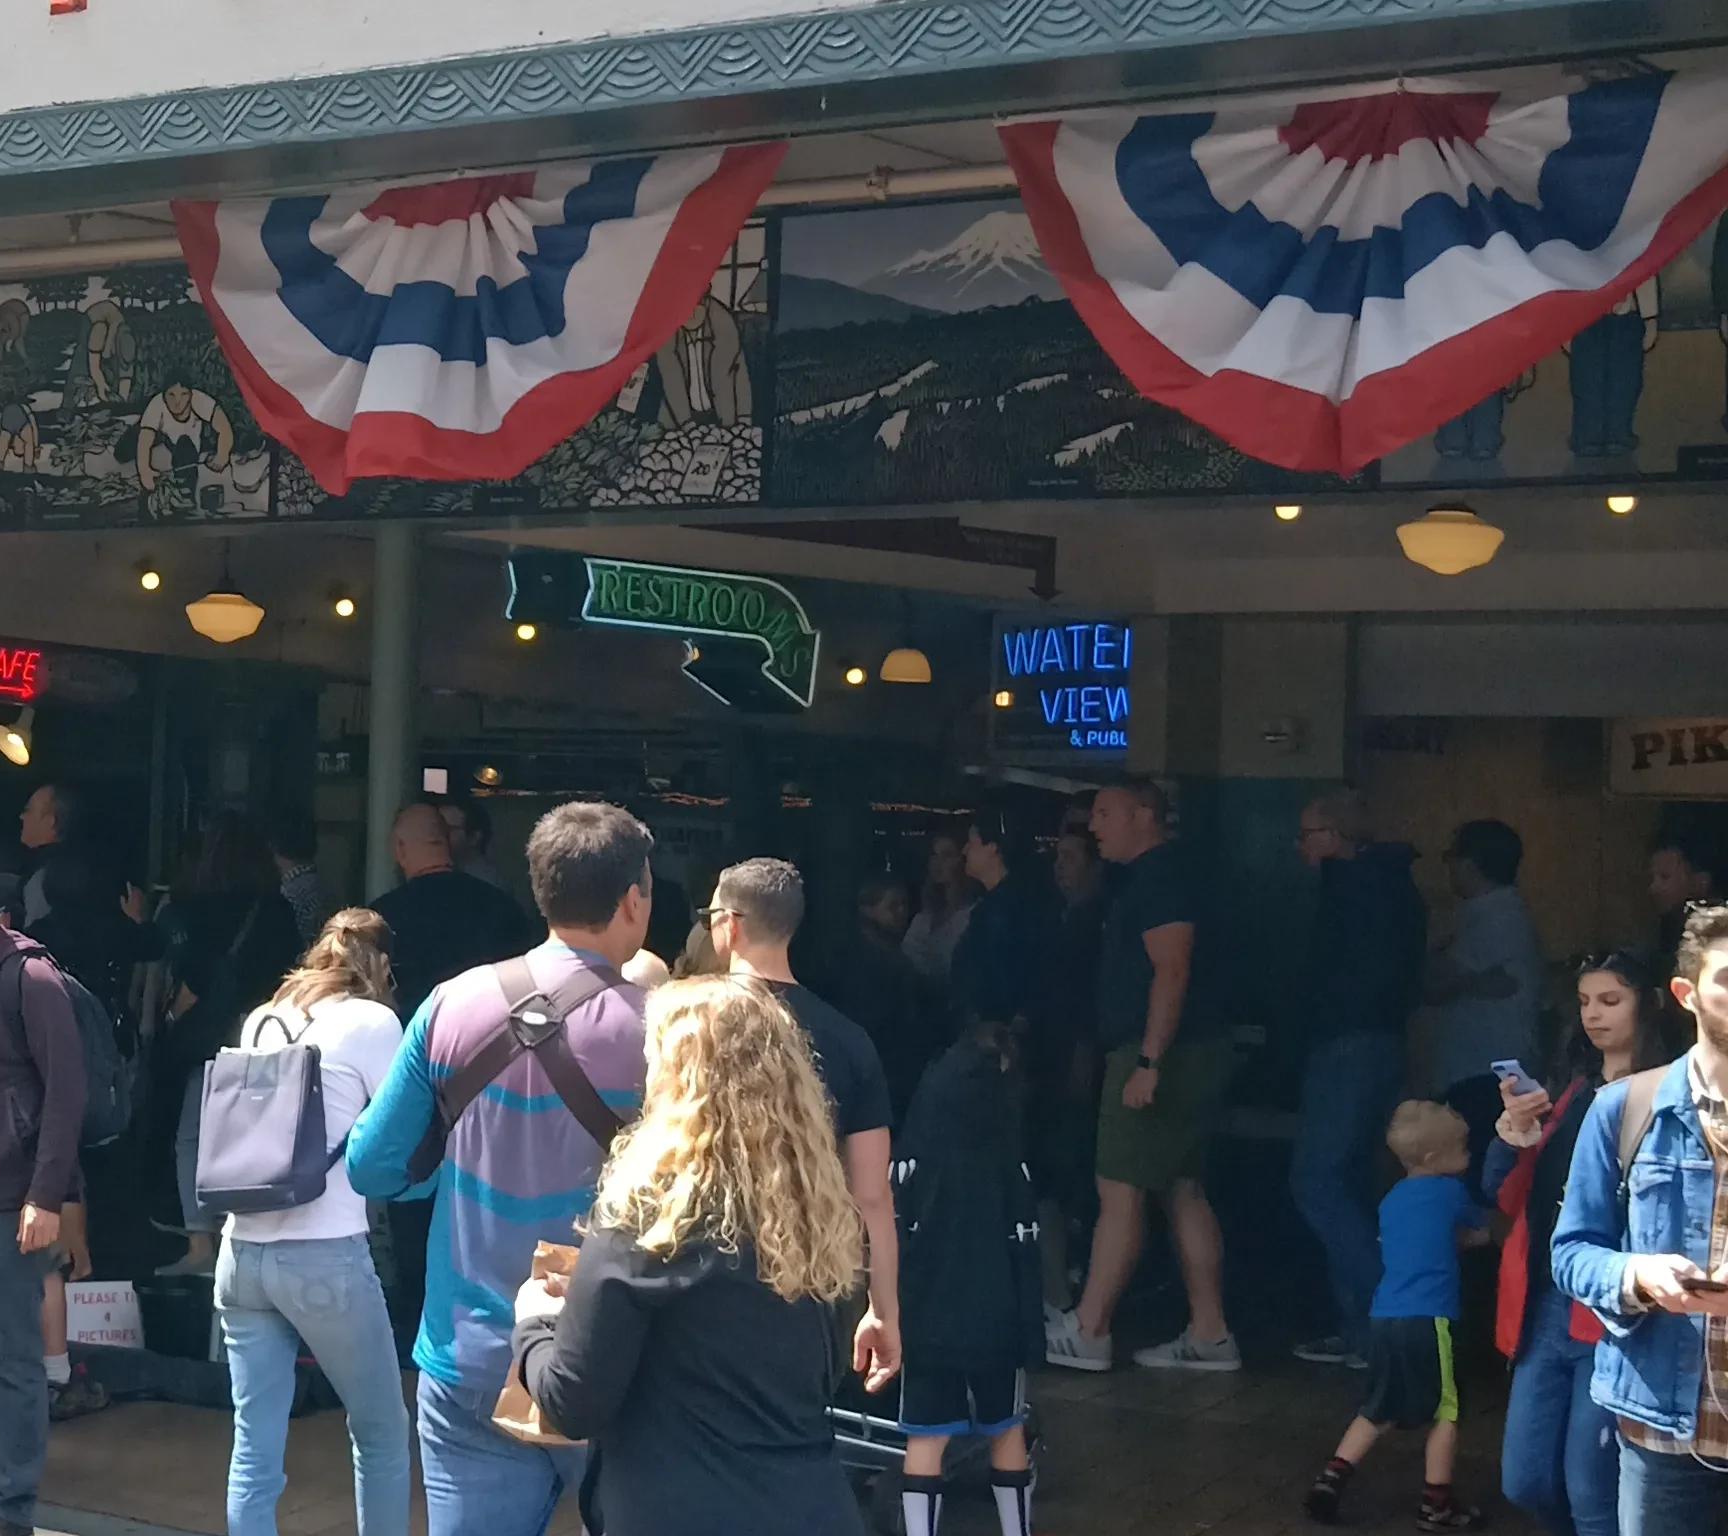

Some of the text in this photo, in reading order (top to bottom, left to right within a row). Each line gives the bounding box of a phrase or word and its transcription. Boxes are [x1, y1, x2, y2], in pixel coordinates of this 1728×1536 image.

[600, 568, 812, 678] RESTROOMS
[74, 1292, 119, 1304] PLEASE
[78, 1328, 136, 1341] PICTURES
